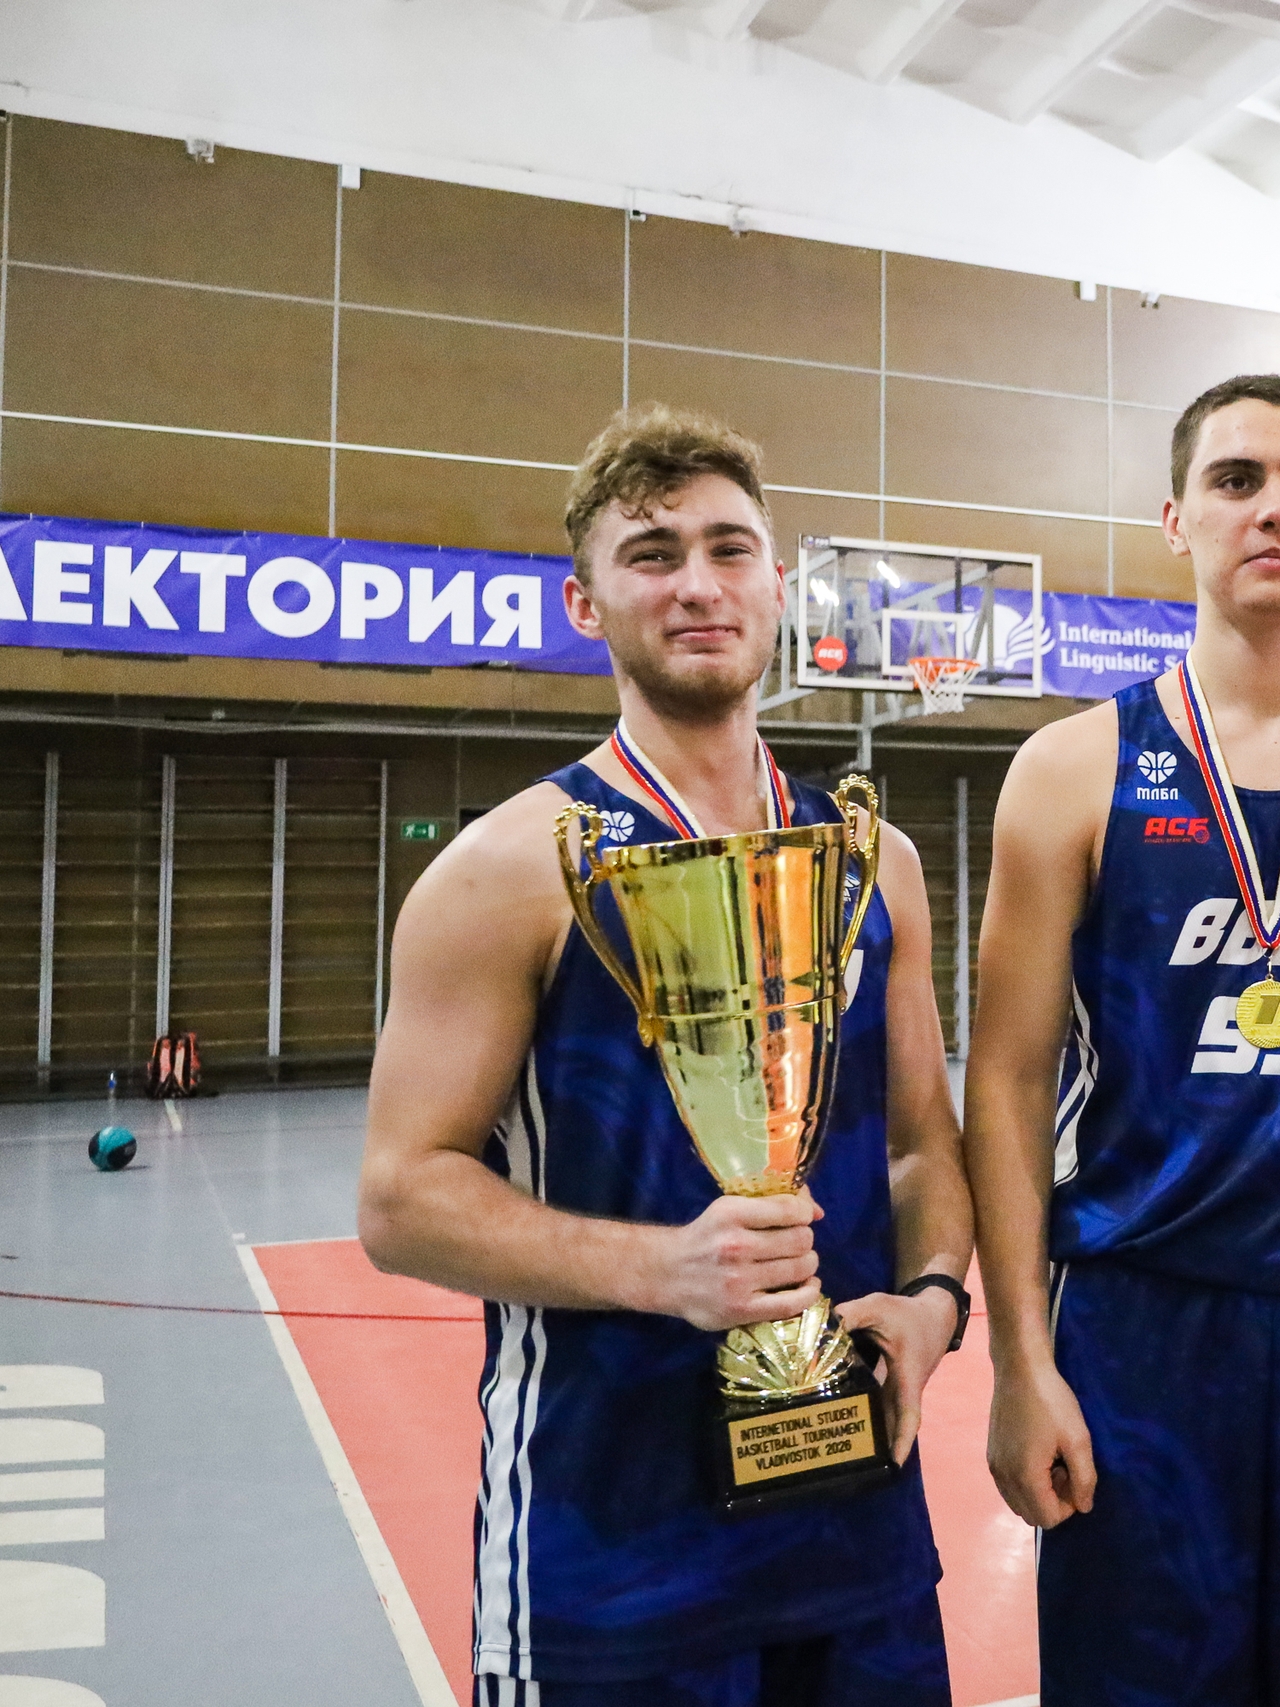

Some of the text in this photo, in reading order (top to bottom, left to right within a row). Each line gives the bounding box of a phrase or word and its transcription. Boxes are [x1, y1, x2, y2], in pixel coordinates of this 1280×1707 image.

[1058, 620, 1193, 649] International
[1059, 646, 1160, 675] Linguistic
[1136, 786, 1179, 800] МЛБЛ
[817, 1405, 858, 1425] STUDENT
[736, 1419, 866, 1459] BASKETBALL TOURNAMENT
[755, 1446, 821, 1470] VLADIVOSTOK
